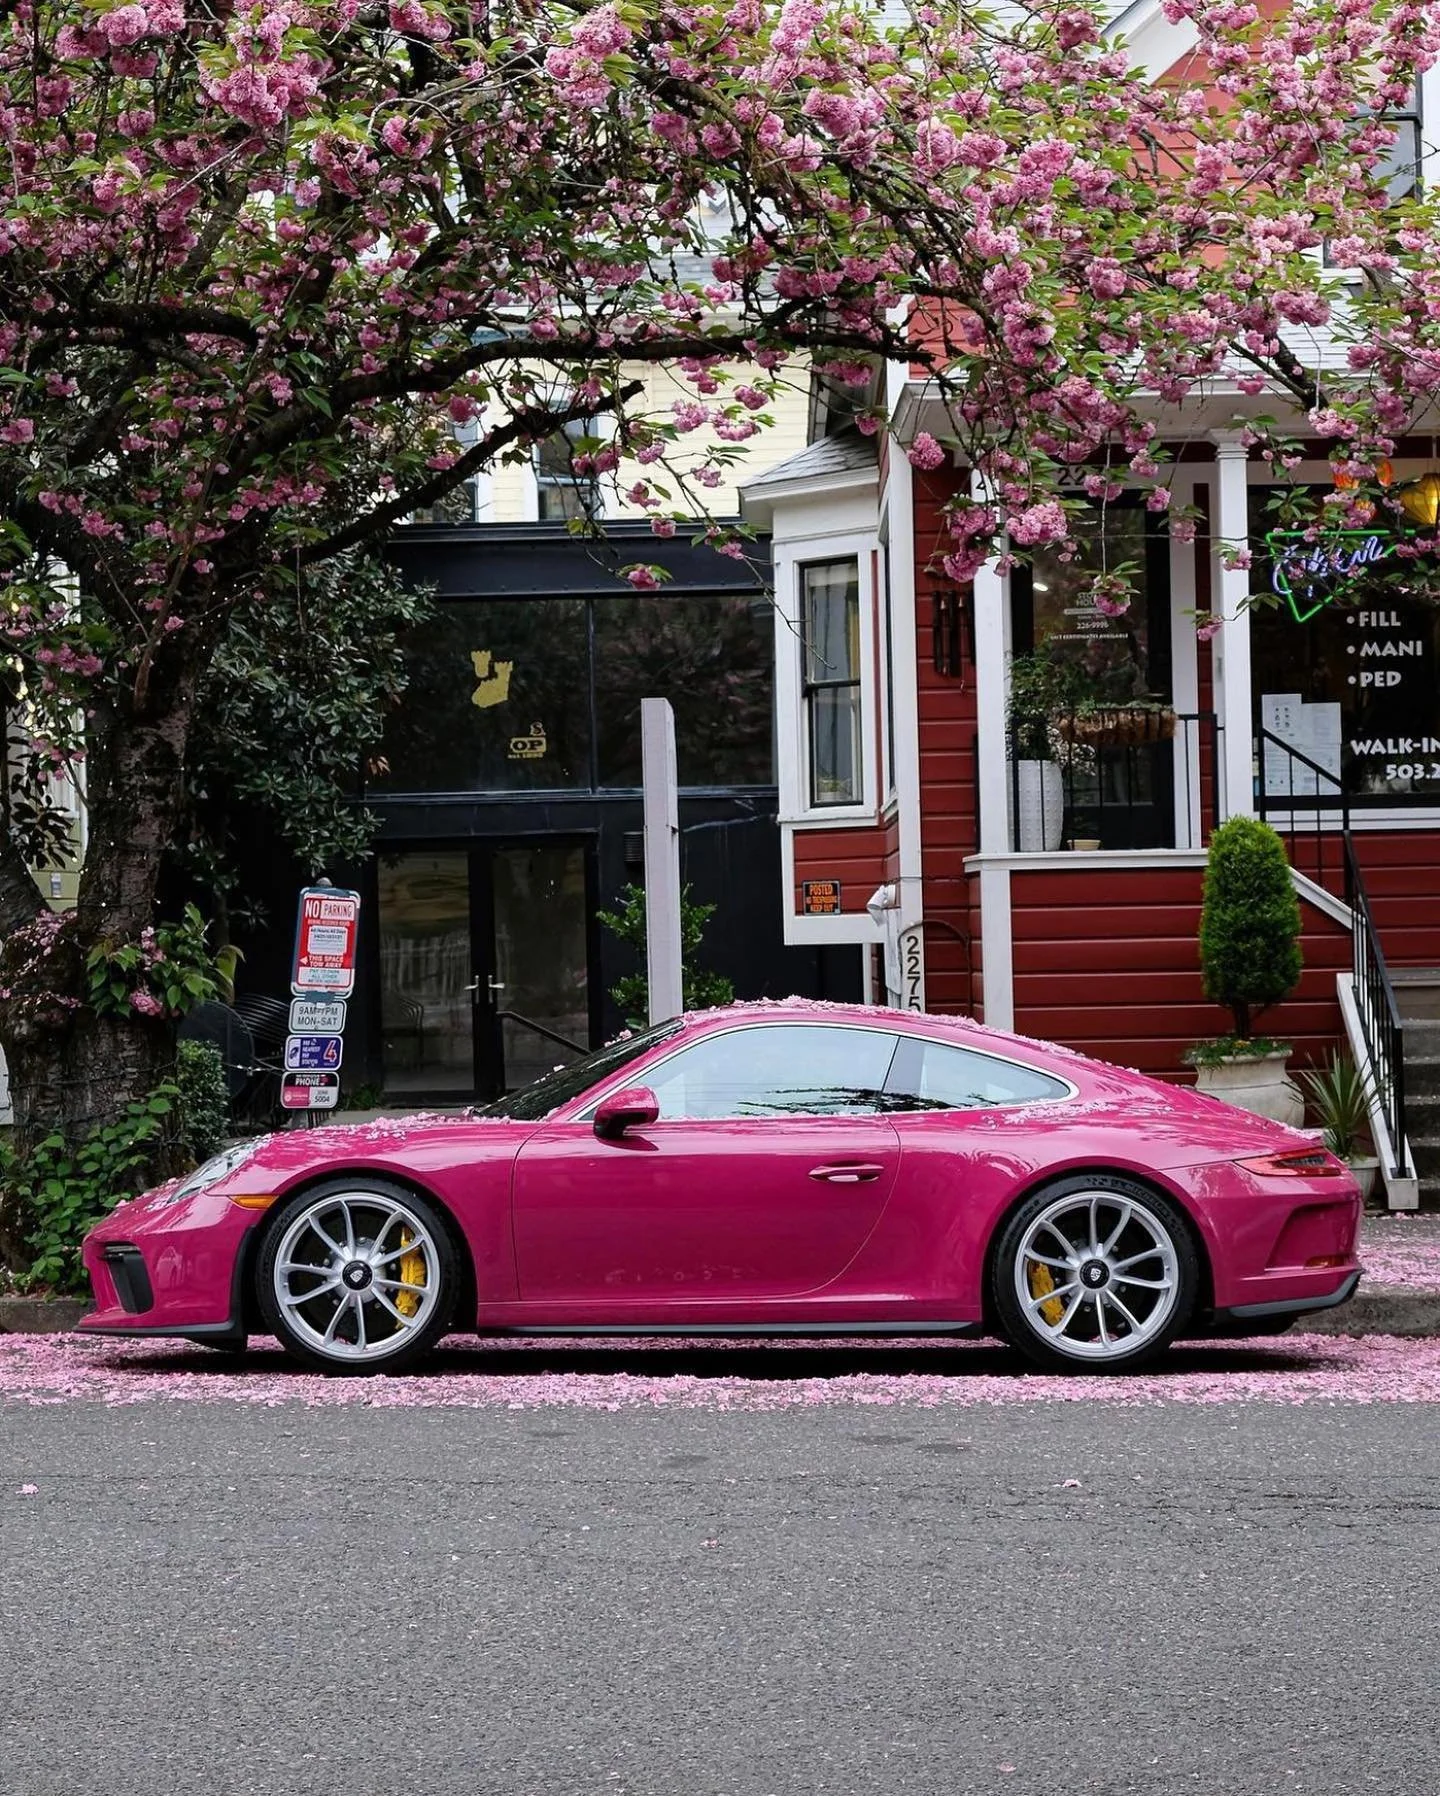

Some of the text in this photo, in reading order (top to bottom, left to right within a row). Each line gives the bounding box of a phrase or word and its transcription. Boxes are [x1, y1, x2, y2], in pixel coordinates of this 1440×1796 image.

[1359, 611, 1401, 627] FILL
[1360, 641, 1423, 657] MANI
[1360, 671, 1402, 688] PED
[1386, 763, 1440, 780] 503.2
[810, 884, 833, 895] POSTED
[305, 899, 352, 918] NO PARKING
[906, 936, 921, 1012] 2275
[298, 1016, 338, 1025] MON-SAT
[323, 1039, 337, 1062] 4
[295, 1077, 320, 1086] PHONE
